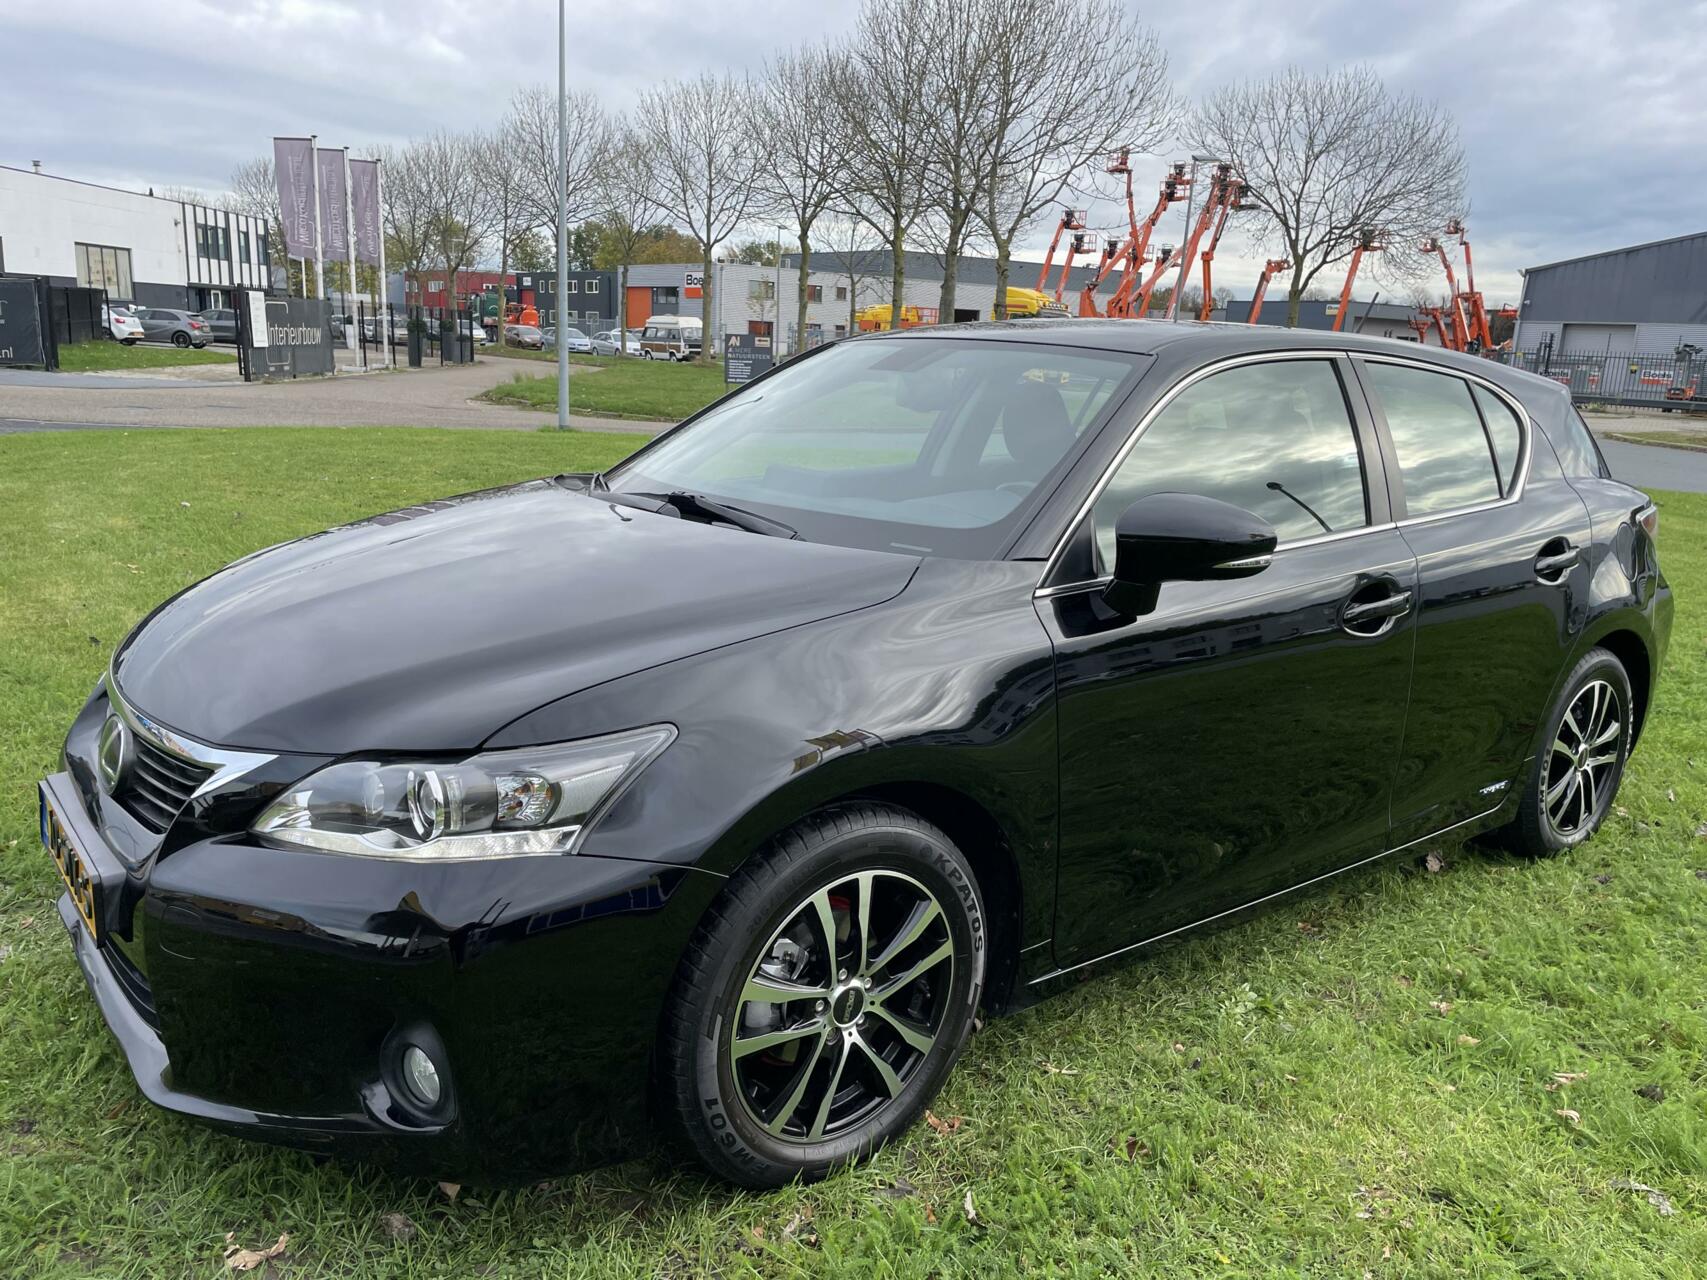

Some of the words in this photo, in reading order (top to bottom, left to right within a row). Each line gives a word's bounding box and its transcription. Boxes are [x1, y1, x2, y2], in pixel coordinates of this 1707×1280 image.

[686, 274, 704, 285] Boe
[267, 321, 321, 345] Interieurbouw
[933, 852, 984, 953] KPATOS
